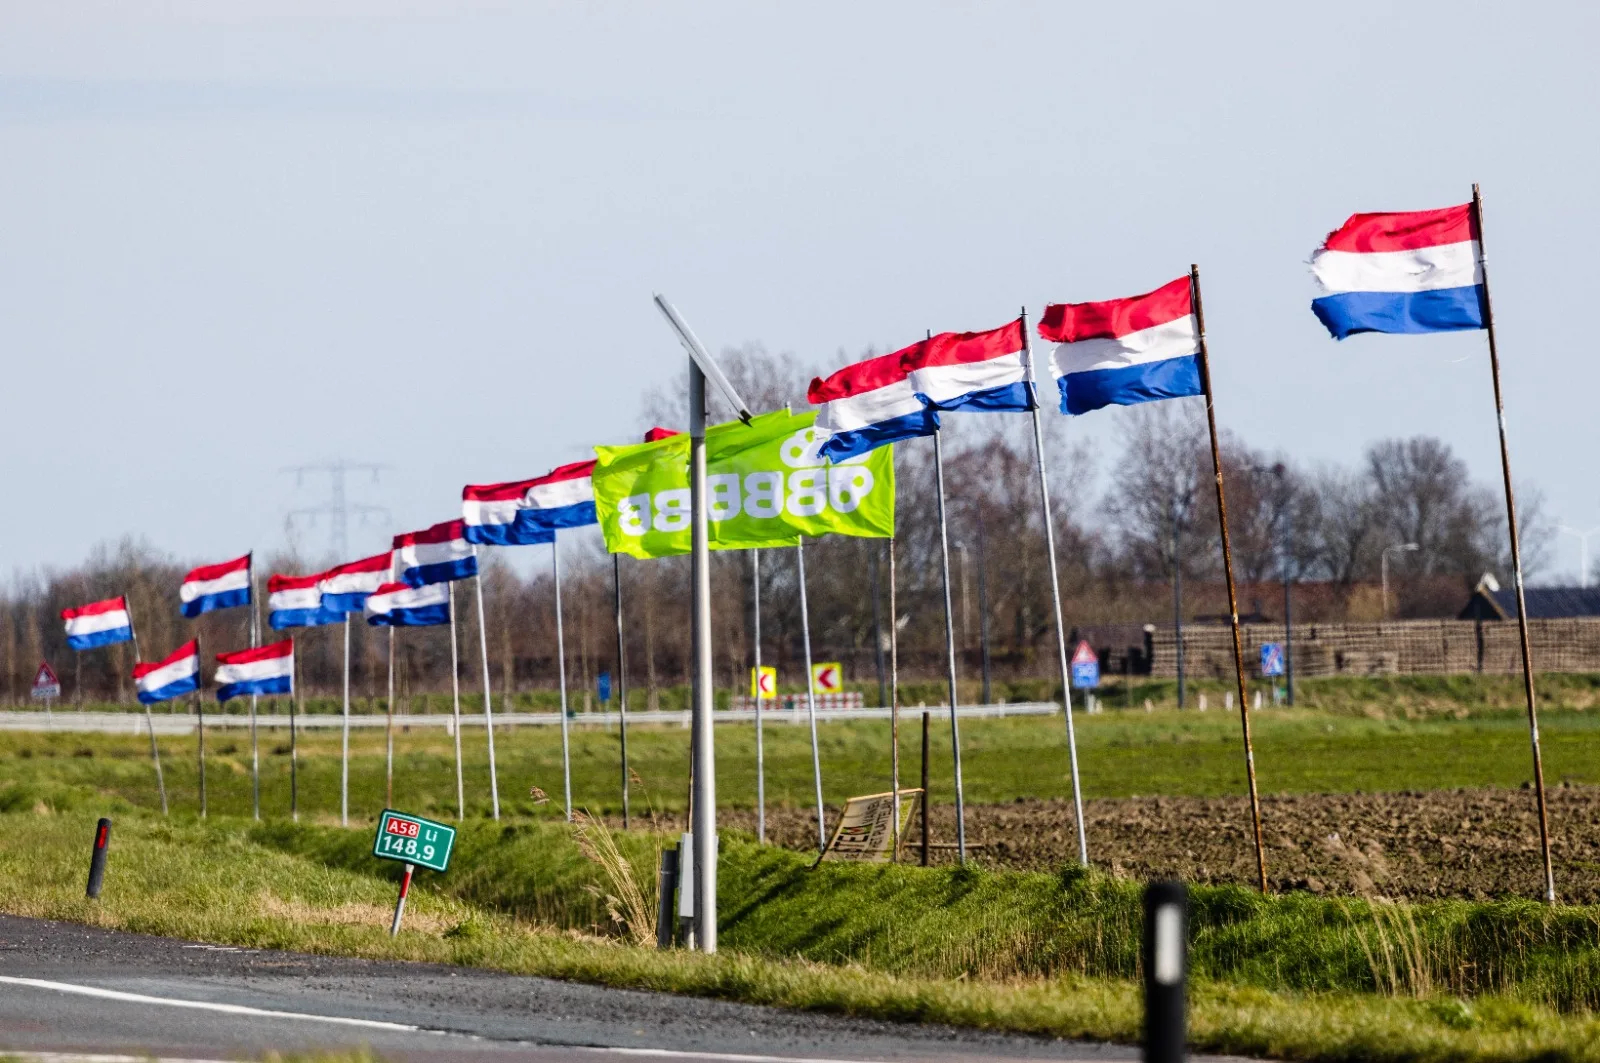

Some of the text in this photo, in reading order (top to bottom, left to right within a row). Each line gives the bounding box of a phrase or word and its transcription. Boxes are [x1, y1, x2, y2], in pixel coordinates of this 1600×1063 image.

[388, 820, 438, 842] A58 Li
[383, 835, 435, 861] 148,9
